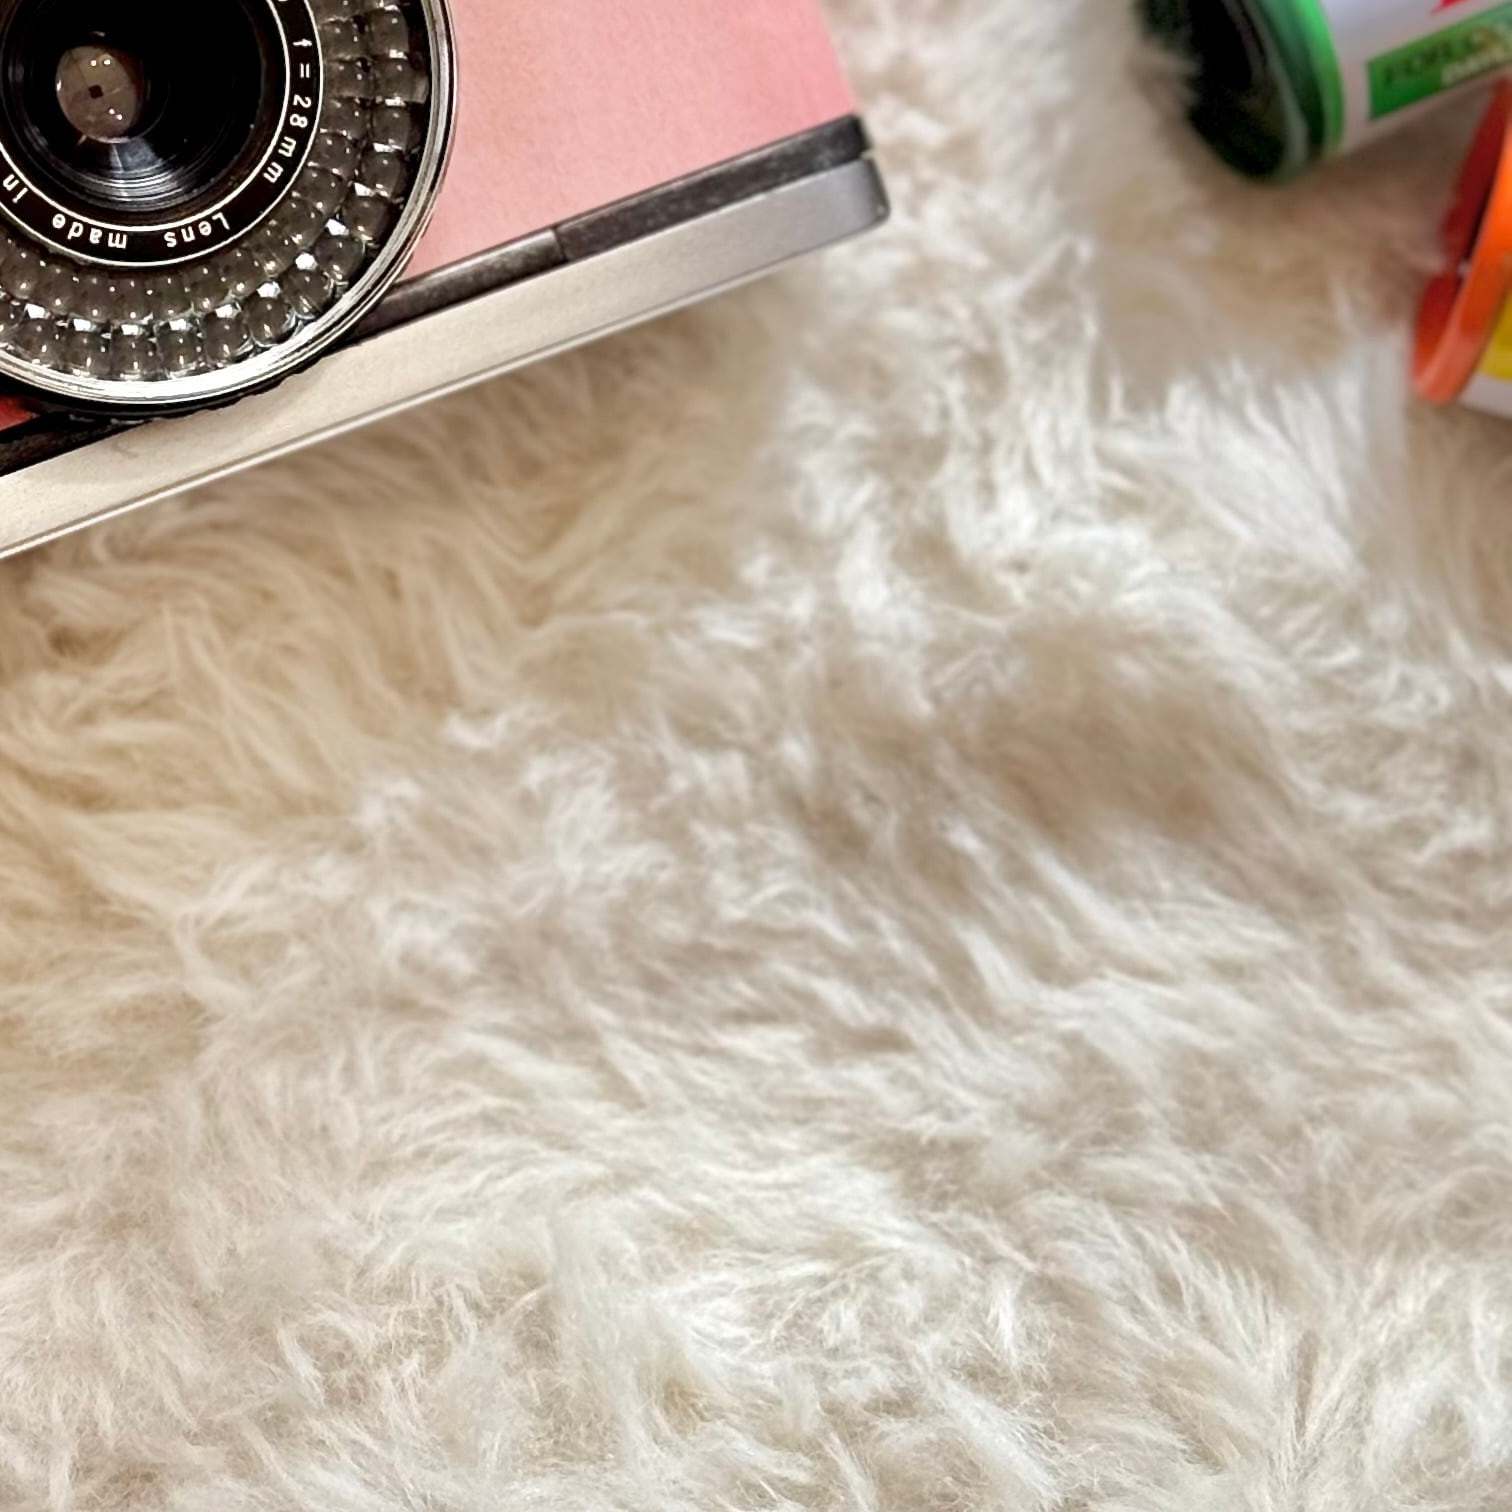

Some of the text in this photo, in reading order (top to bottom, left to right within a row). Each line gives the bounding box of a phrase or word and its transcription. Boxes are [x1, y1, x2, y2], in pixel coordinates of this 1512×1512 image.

[1, 172, 30, 205] in
[51, 212, 129, 250] made
[162, 210, 231, 249] Lens
